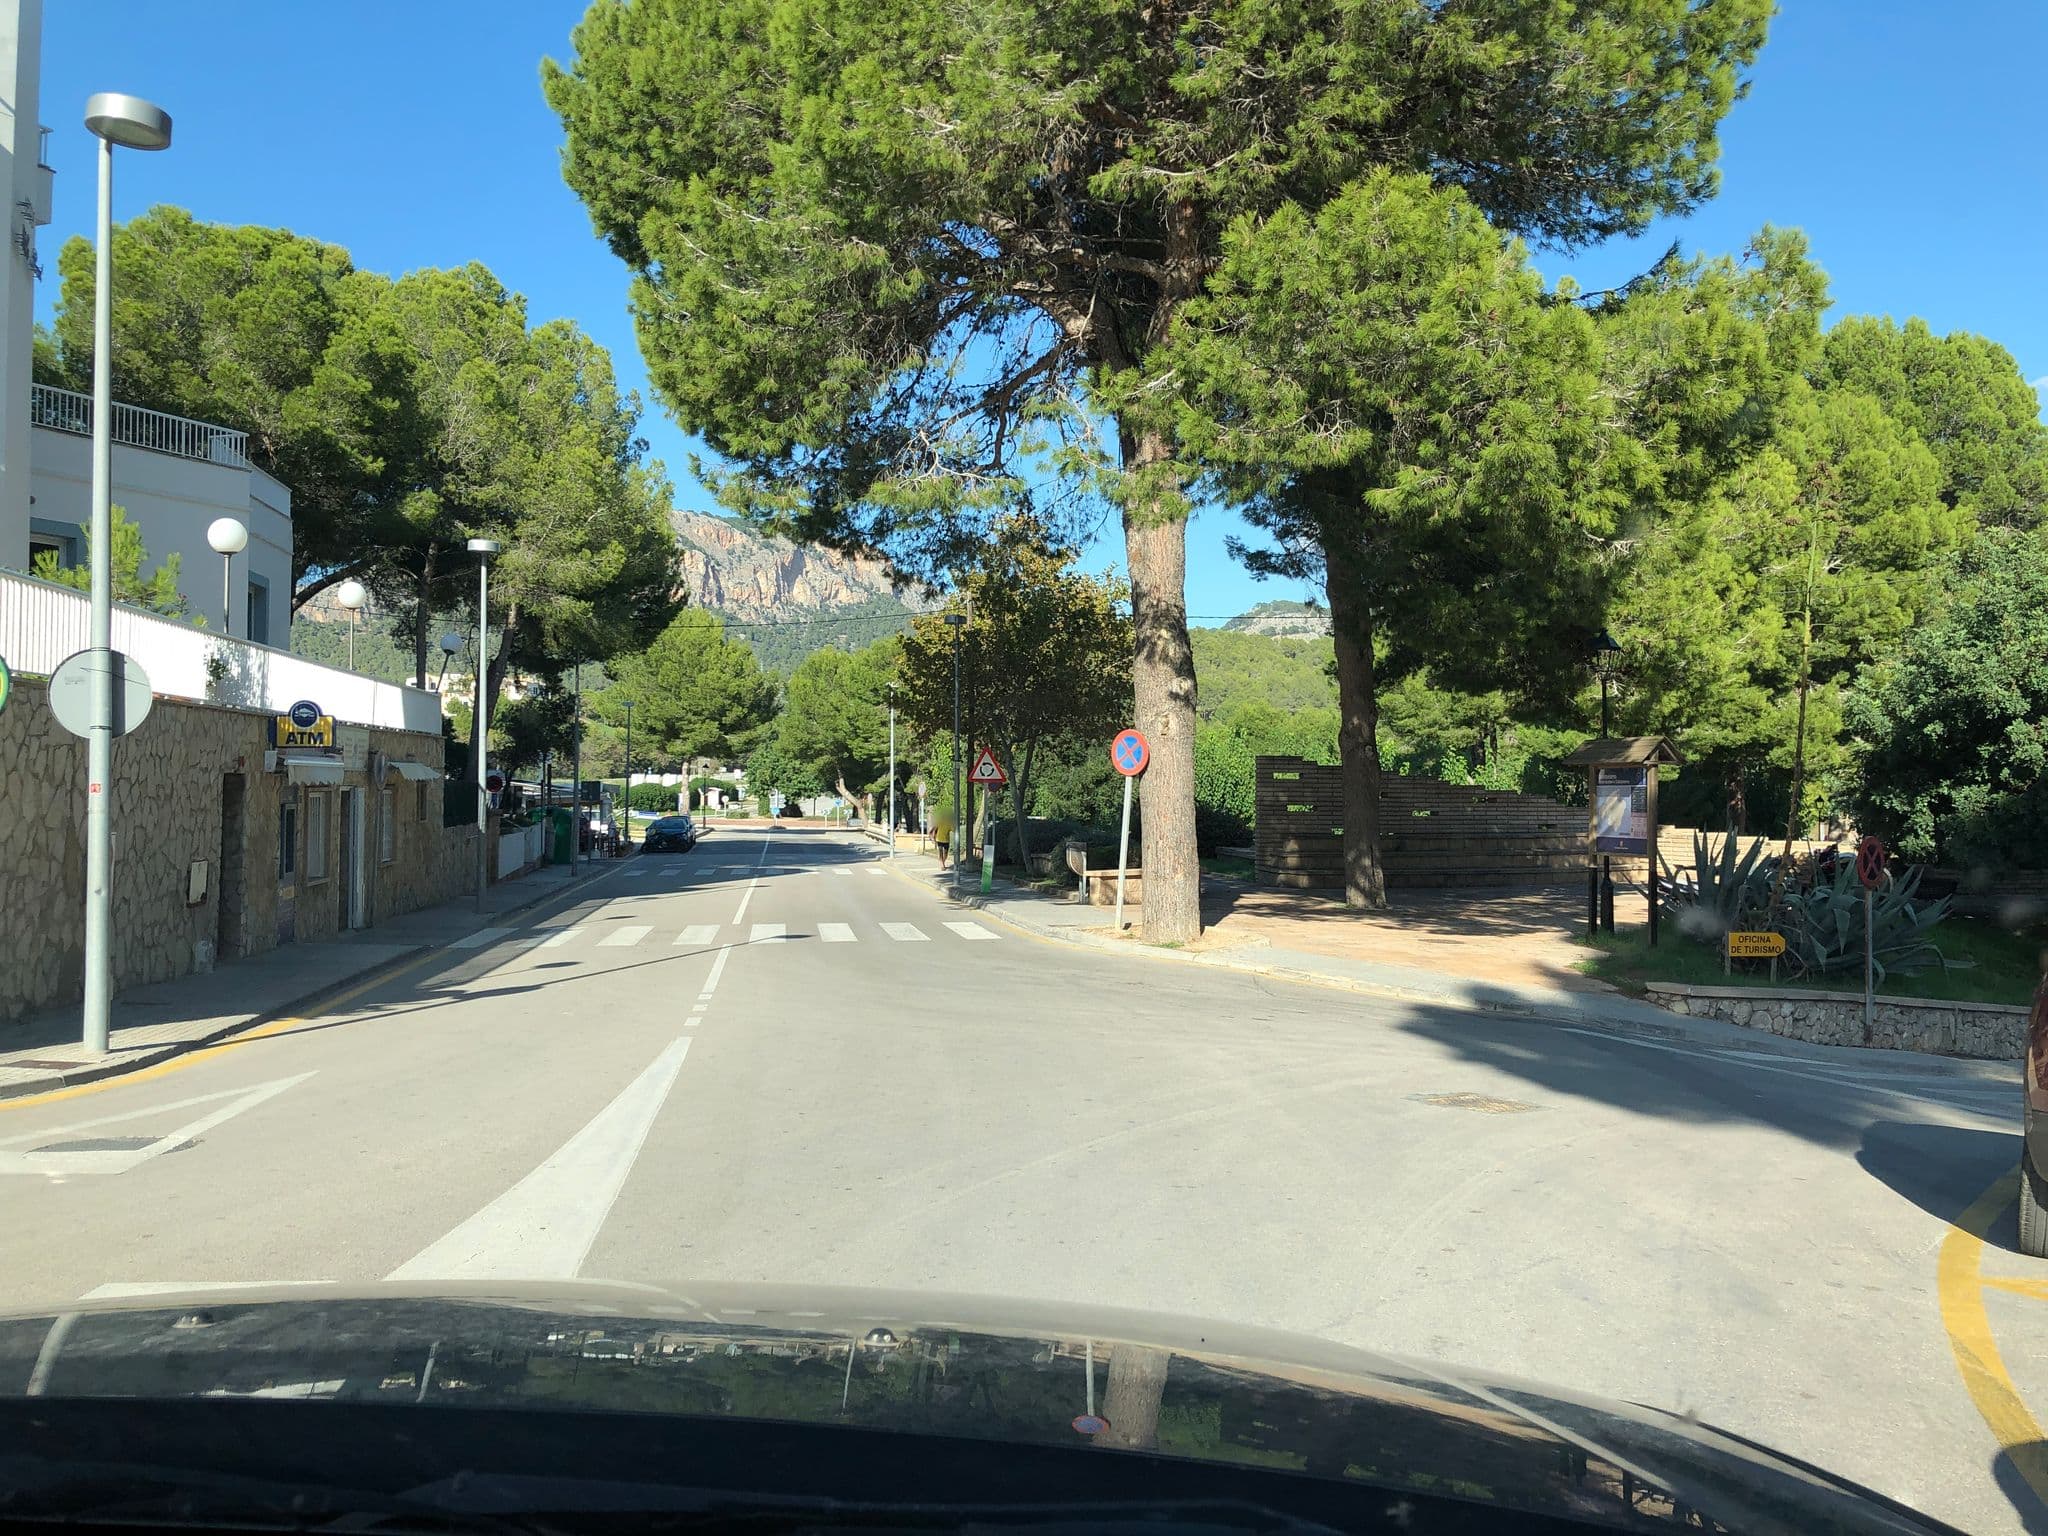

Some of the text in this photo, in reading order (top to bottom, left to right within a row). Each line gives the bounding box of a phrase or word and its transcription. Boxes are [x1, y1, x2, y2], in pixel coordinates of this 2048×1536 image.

[286, 732, 324, 744] ATM
[1738, 935, 1771, 943] OFICINA
[1731, 945, 1781, 954] DE TURISMO
